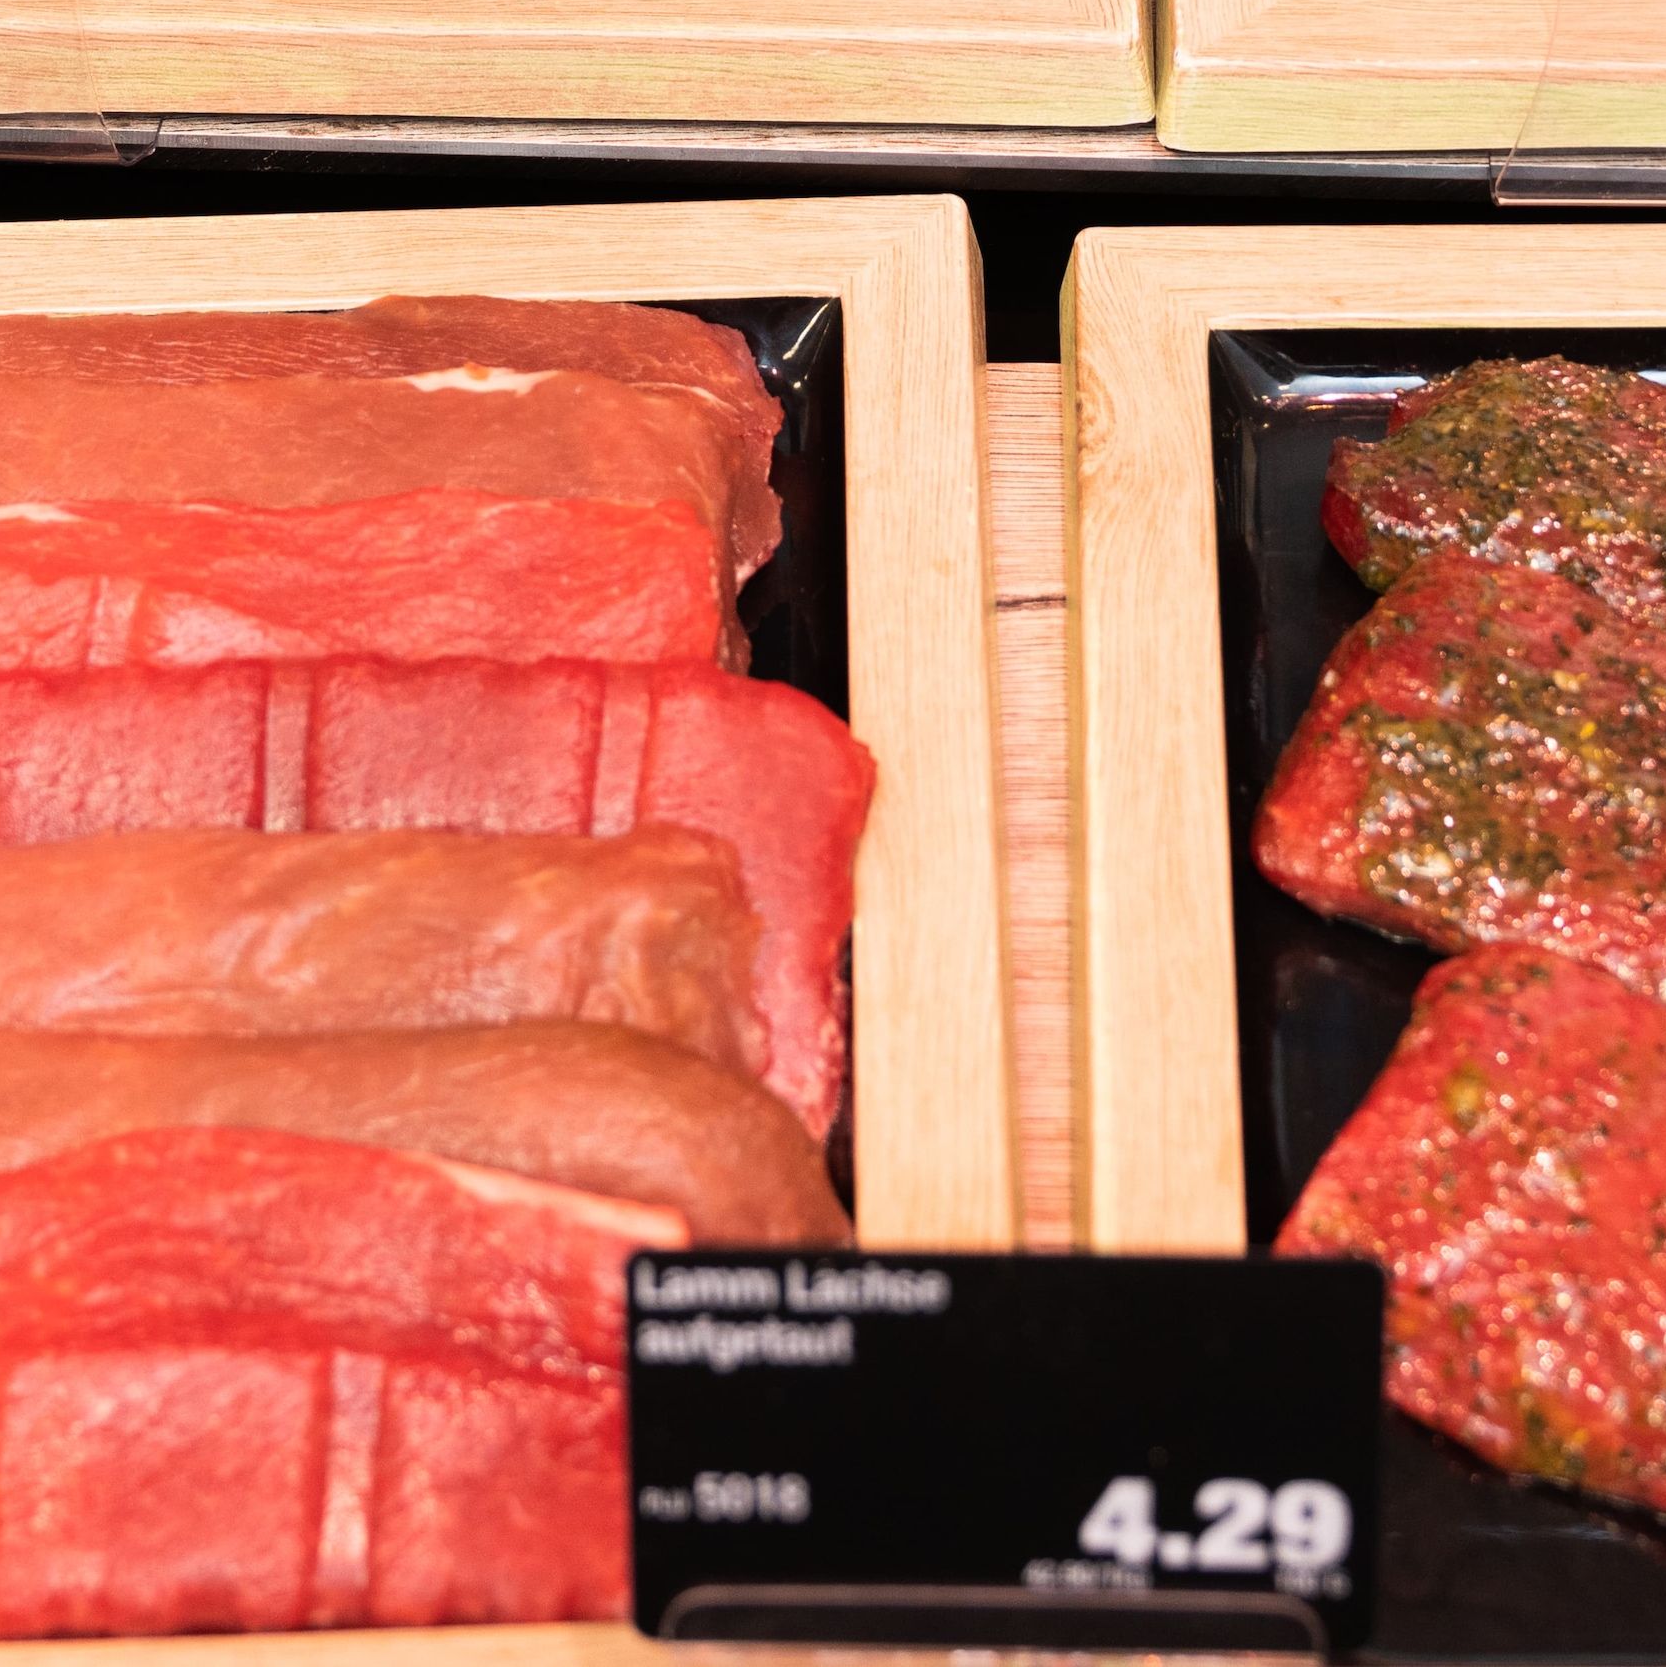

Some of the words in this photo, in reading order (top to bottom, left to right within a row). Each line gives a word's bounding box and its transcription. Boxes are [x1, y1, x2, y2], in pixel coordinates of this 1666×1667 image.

[633, 1259, 779, 1311] Lamm
[785, 1259, 950, 1313] Lachse
[636, 1314, 853, 1372] aufgetaut
[1077, 1475, 1352, 1572] 4.29
